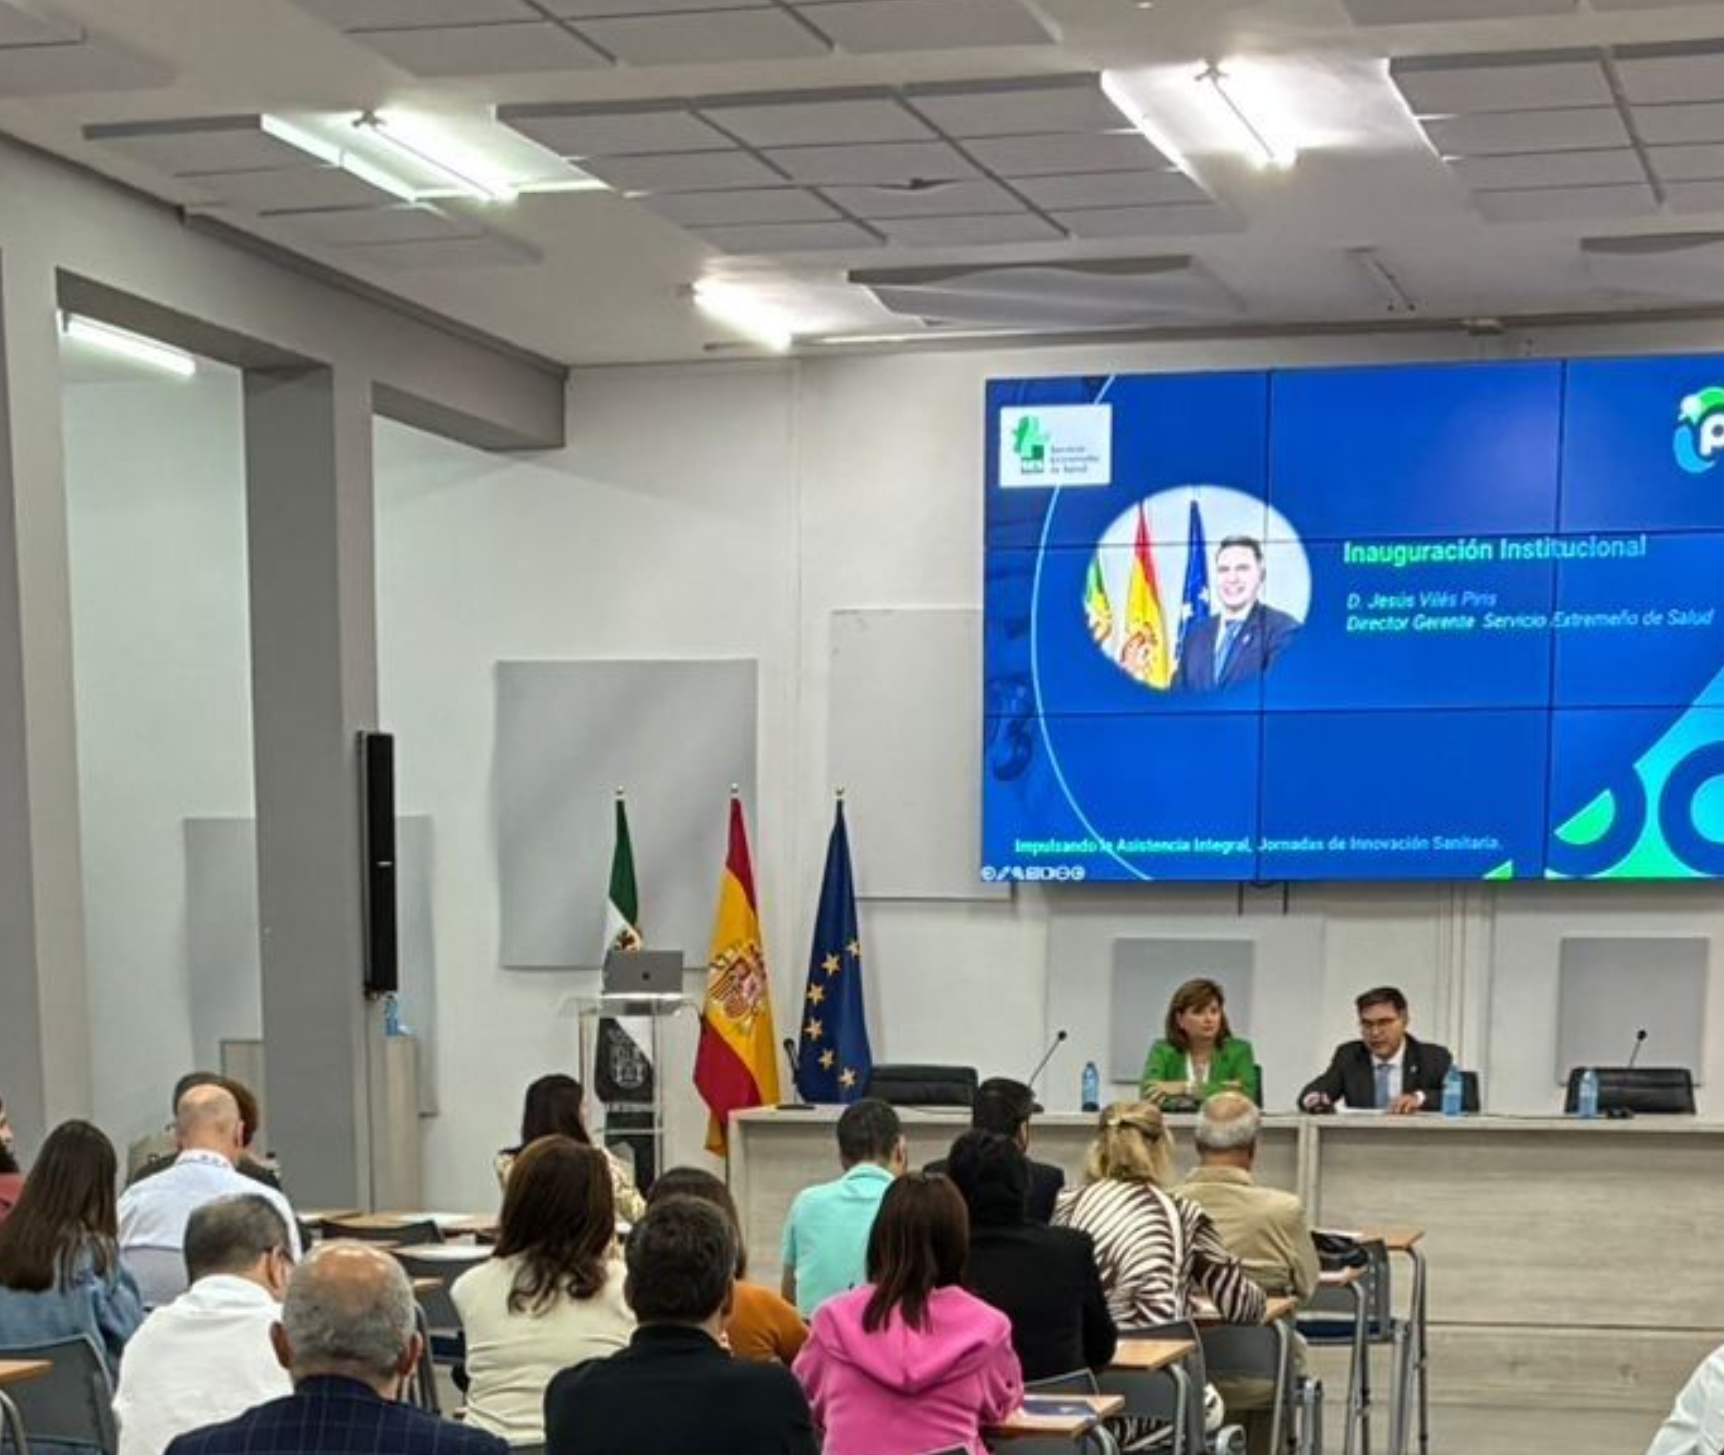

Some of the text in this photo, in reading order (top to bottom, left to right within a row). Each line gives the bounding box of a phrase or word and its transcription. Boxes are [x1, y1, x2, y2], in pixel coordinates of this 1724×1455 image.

[1343, 533, 1647, 568] Inauguración Institucional
[1367, 591, 1415, 609] Jesús
[1346, 614, 1410, 632] Director
[1482, 611, 1547, 629] Servicio
[1642, 609, 1663, 626] de
[1666, 608, 1715, 625] Salud
[1015, 838, 1097, 857] Impulsando
[1117, 838, 1191, 852] Asistencia
[1258, 837, 1324, 852] Jornadas
[1328, 837, 1346, 851] de
[1349, 836, 1430, 851] Innovación
